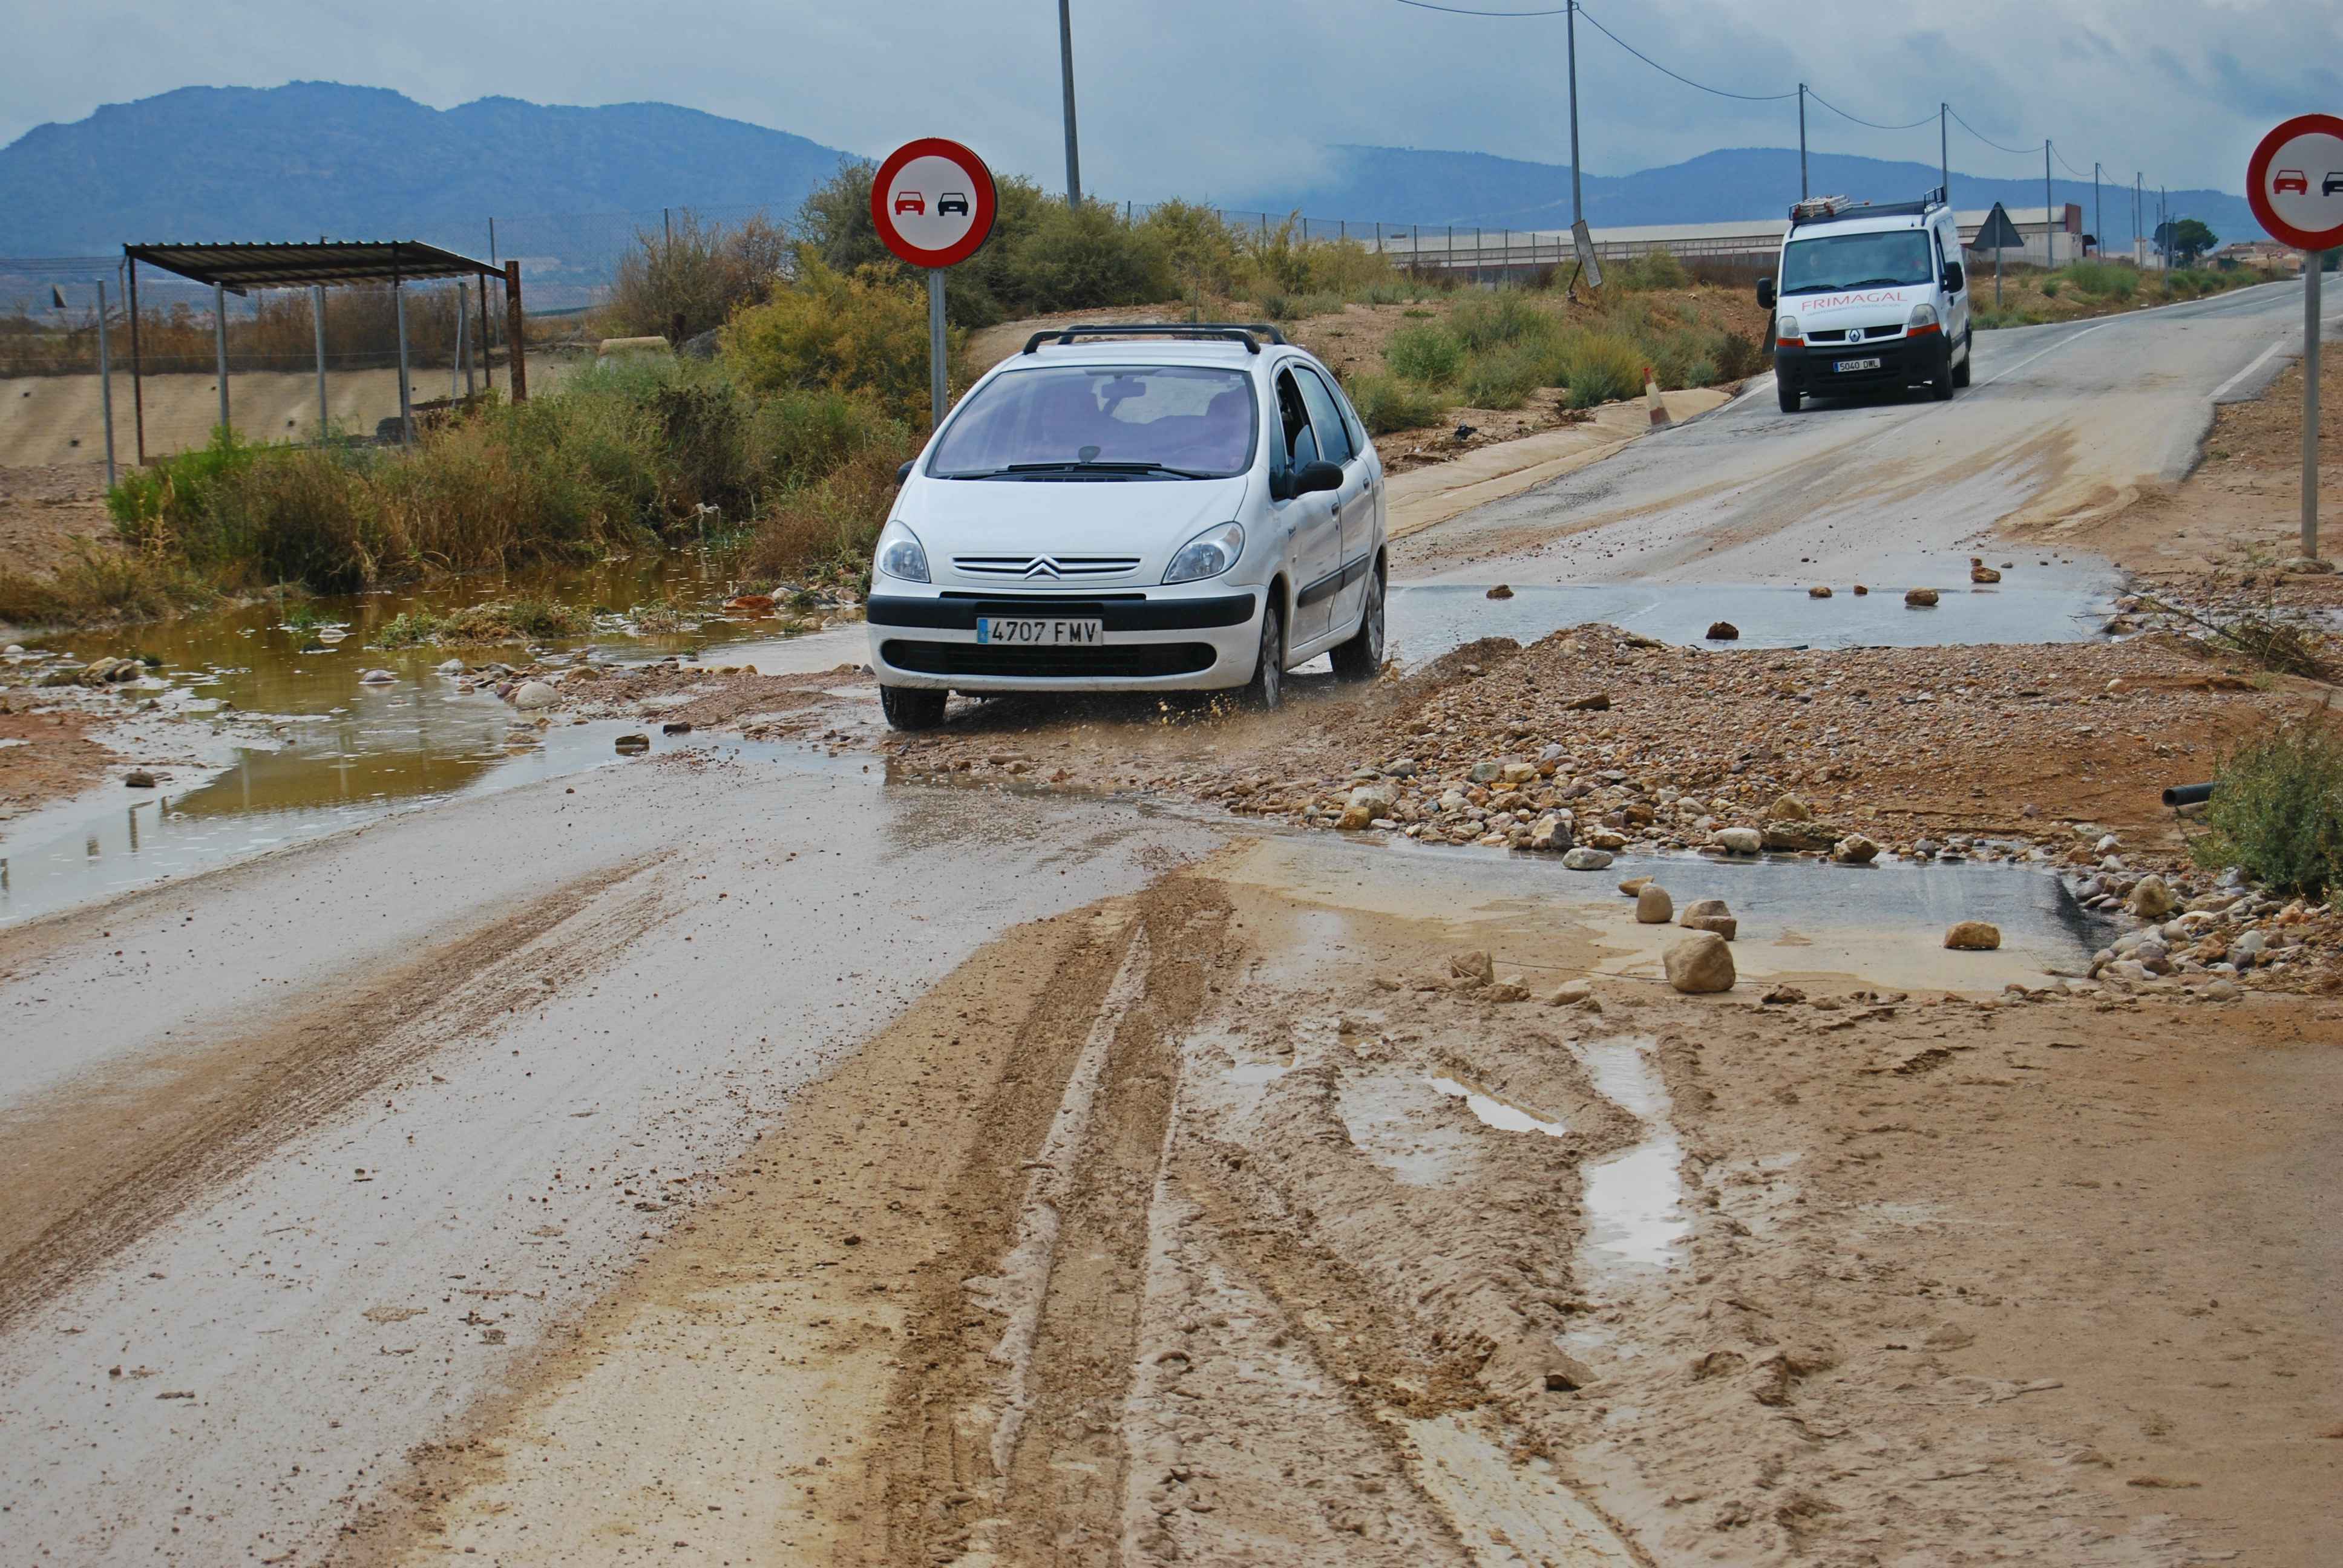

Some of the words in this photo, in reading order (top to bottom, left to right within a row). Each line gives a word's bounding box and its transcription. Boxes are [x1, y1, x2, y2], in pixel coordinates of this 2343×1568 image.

[1801, 292, 1908, 312] FRIMAGAL
[1840, 362, 1860, 371] 5040
[1863, 360, 1878, 368] DWL
[992, 621, 1046, 641] 4707
[1055, 622, 1096, 642] FMV
